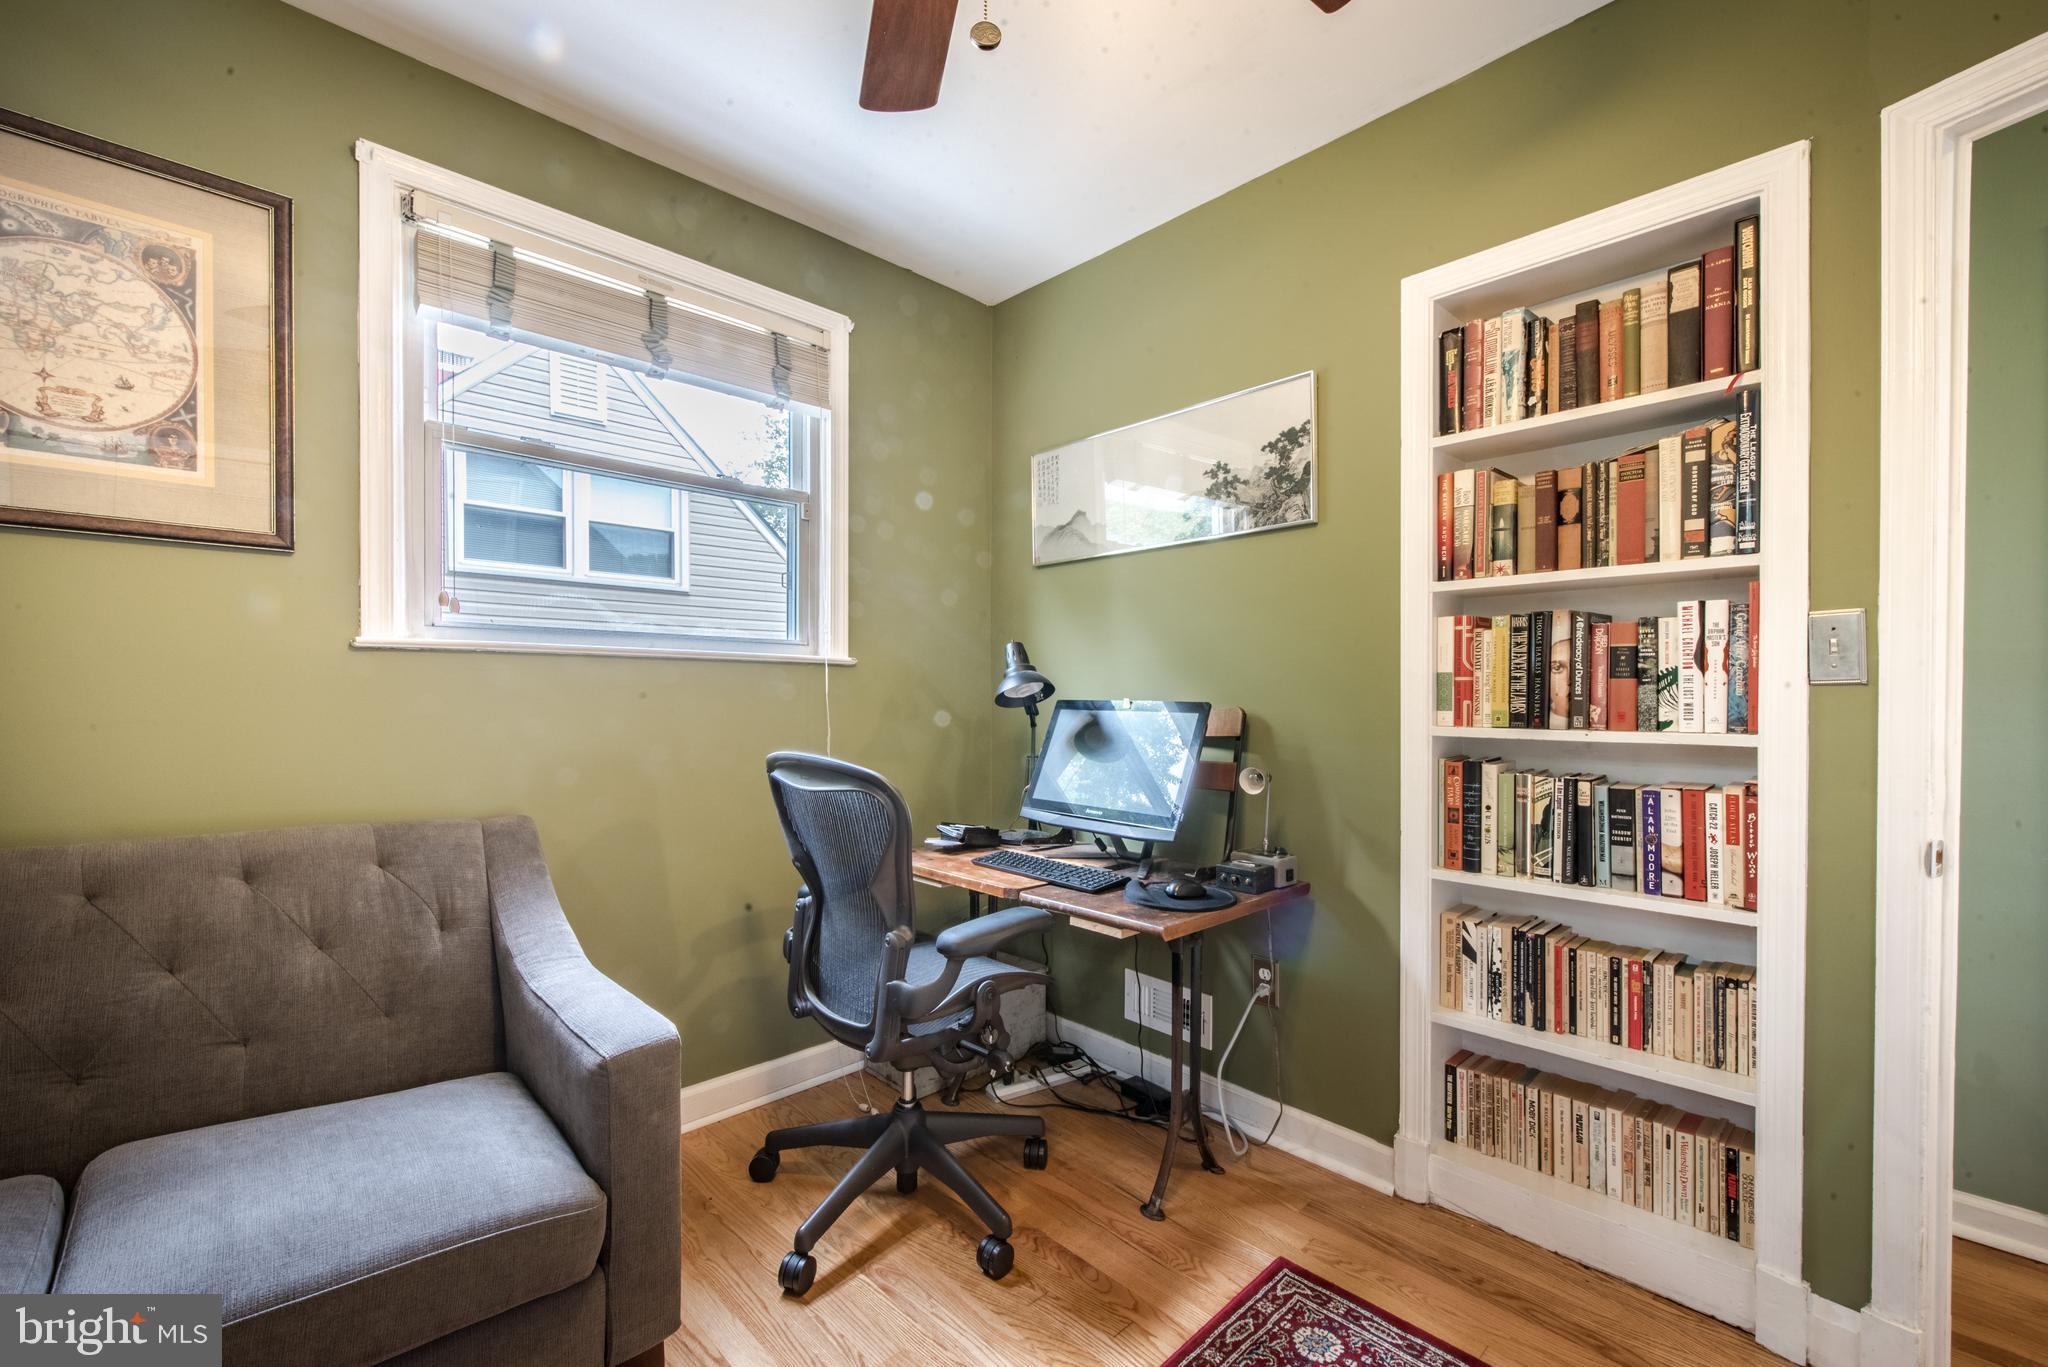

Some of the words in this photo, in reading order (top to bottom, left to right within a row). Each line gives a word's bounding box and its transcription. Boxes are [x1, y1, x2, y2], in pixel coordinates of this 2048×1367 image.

[1741, 224, 1754, 270] WATCHMEN
[1705, 300, 1732, 311] NARNIA
[1485, 328, 1500, 377] SILMARILLION
[1607, 330, 1618, 368] ULYSSES
[1739, 412, 1751, 459] EXTRAORDINARY
[1749, 424, 1757, 441] THE
[1749, 442, 1757, 470] LEAGUE
[1739, 459, 1751, 494] GENTLEMEN
[1749, 472, 1757, 482] OF
[1535, 615, 1543, 645] THOMAS
[1682, 606, 1694, 634] MICHAEL
[1734, 612, 1747, 637] Going
[1474, 631, 1482, 653] BLIND
[1512, 631, 1528, 646] THE
[1575, 622, 1584, 661] Confederacy
[1594, 628, 1604, 656] DRAGON
[1600, 634, 1608, 648] RED
[1734, 637, 1747, 660] After
[1474, 653, 1482, 672] DATE
[1511, 645, 1528, 671] SILENCE
[1535, 646, 1543, 675] HARRIS
[1682, 637, 1694, 670] CRICHTON
[1511, 680, 1527, 692] THE
[1575, 670, 1584, 695] Dunces
[1682, 674, 1694, 686] THE
[1734, 660, 1747, 697] Cacciato
[1510, 692, 1527, 714] LAMBS
[1535, 677, 1543, 717] HANNIBAL
[1682, 687, 1694, 701] LOST
[1682, 702, 1694, 722] WORLD
[1452, 776, 1461, 806] COMPANY
[1647, 796, 1655, 834] ALAN
[1709, 802, 1718, 831] CATCH-22
[1730, 796, 1738, 820] CLOUD
[1730, 821, 1738, 845] ATLAS
[1647, 843, 1655, 891] MOORE
[1710, 847, 1719, 869] JOSEPH
[1710, 870, 1719, 890] HELLER
[1576, 1113, 1584, 1145] PAPILLON
[1679, 1140, 1689, 1177] Watership
[1679, 1176, 1689, 1199] Down
[1728, 1173, 1738, 1200] PLATOON
[1741, 1173, 1749, 1182] OF
[1747, 1174, 1755, 1187] ONE
[1741, 1182, 1749, 1203] SOLITUDE
[1747, 1186, 1755, 1210] HUNDRED
[1747, 1209, 1755, 1225] YEARS
